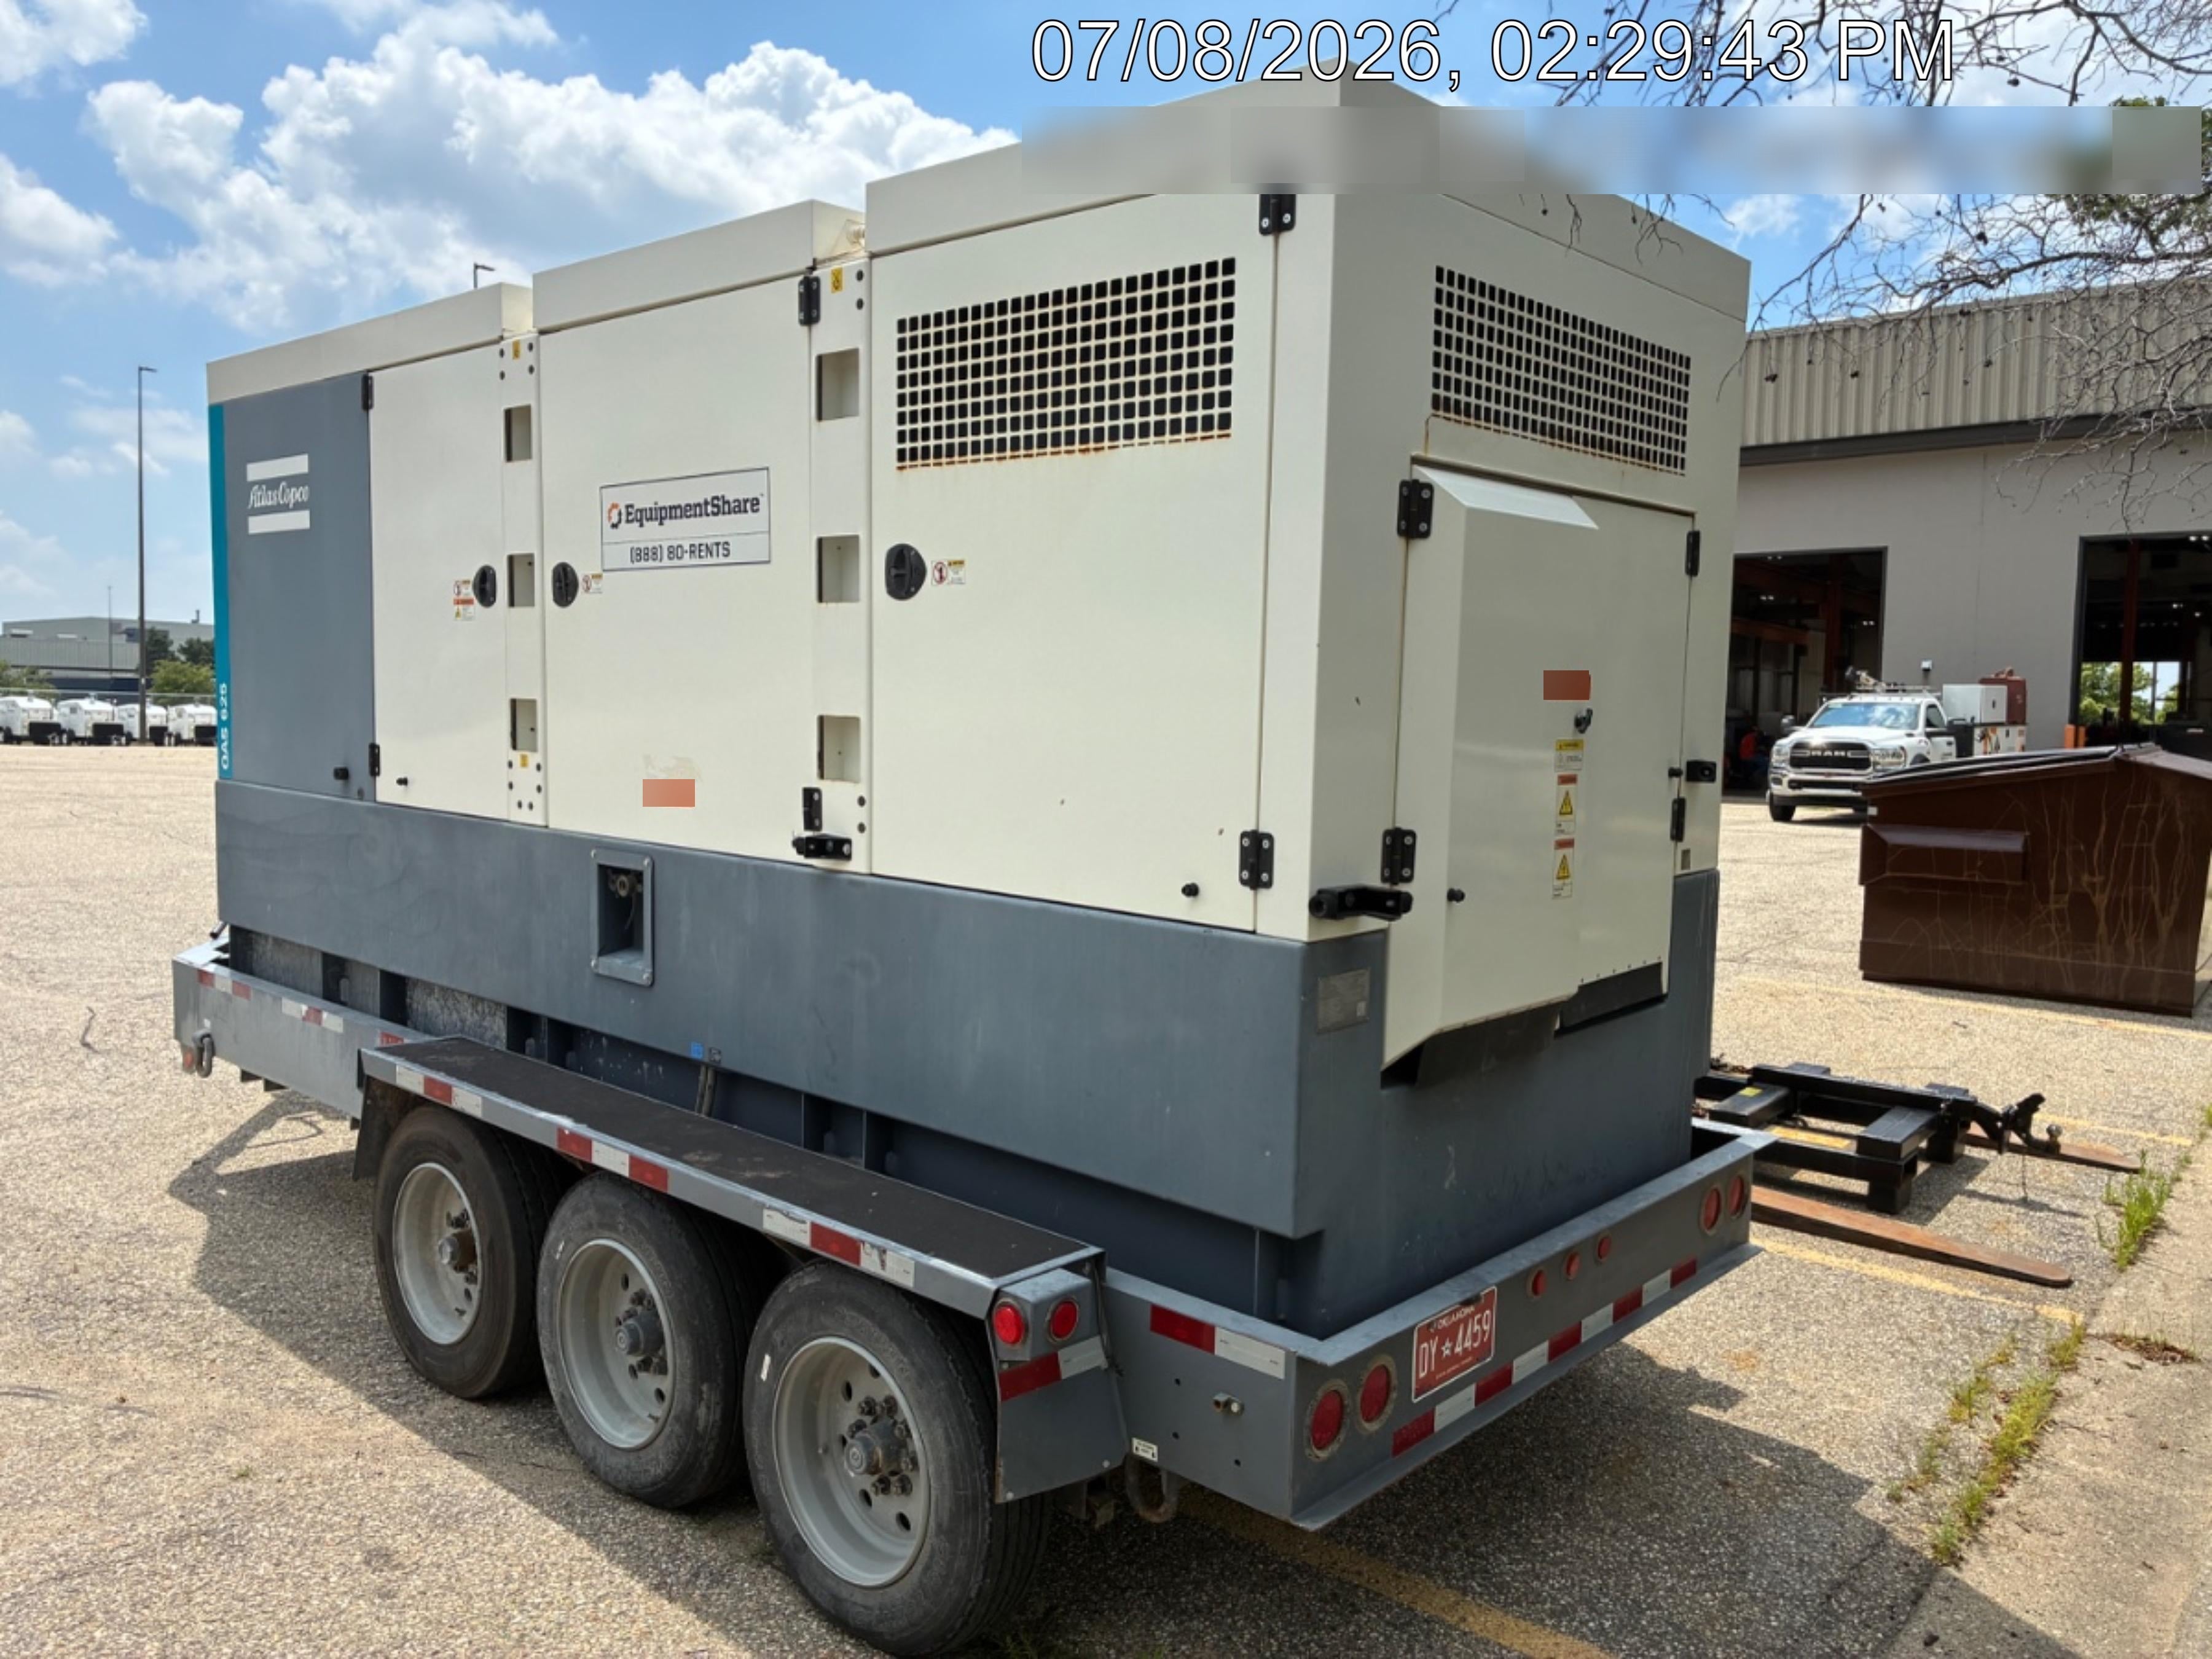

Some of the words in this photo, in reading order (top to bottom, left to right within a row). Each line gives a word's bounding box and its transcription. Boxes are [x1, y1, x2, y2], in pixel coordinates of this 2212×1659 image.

[624, 494, 761, 528] EquipmentShare
[630, 545, 662, 564] (888)
[1419, 1335, 1439, 1379] DY
[1454, 1309, 1492, 1356] 4459
